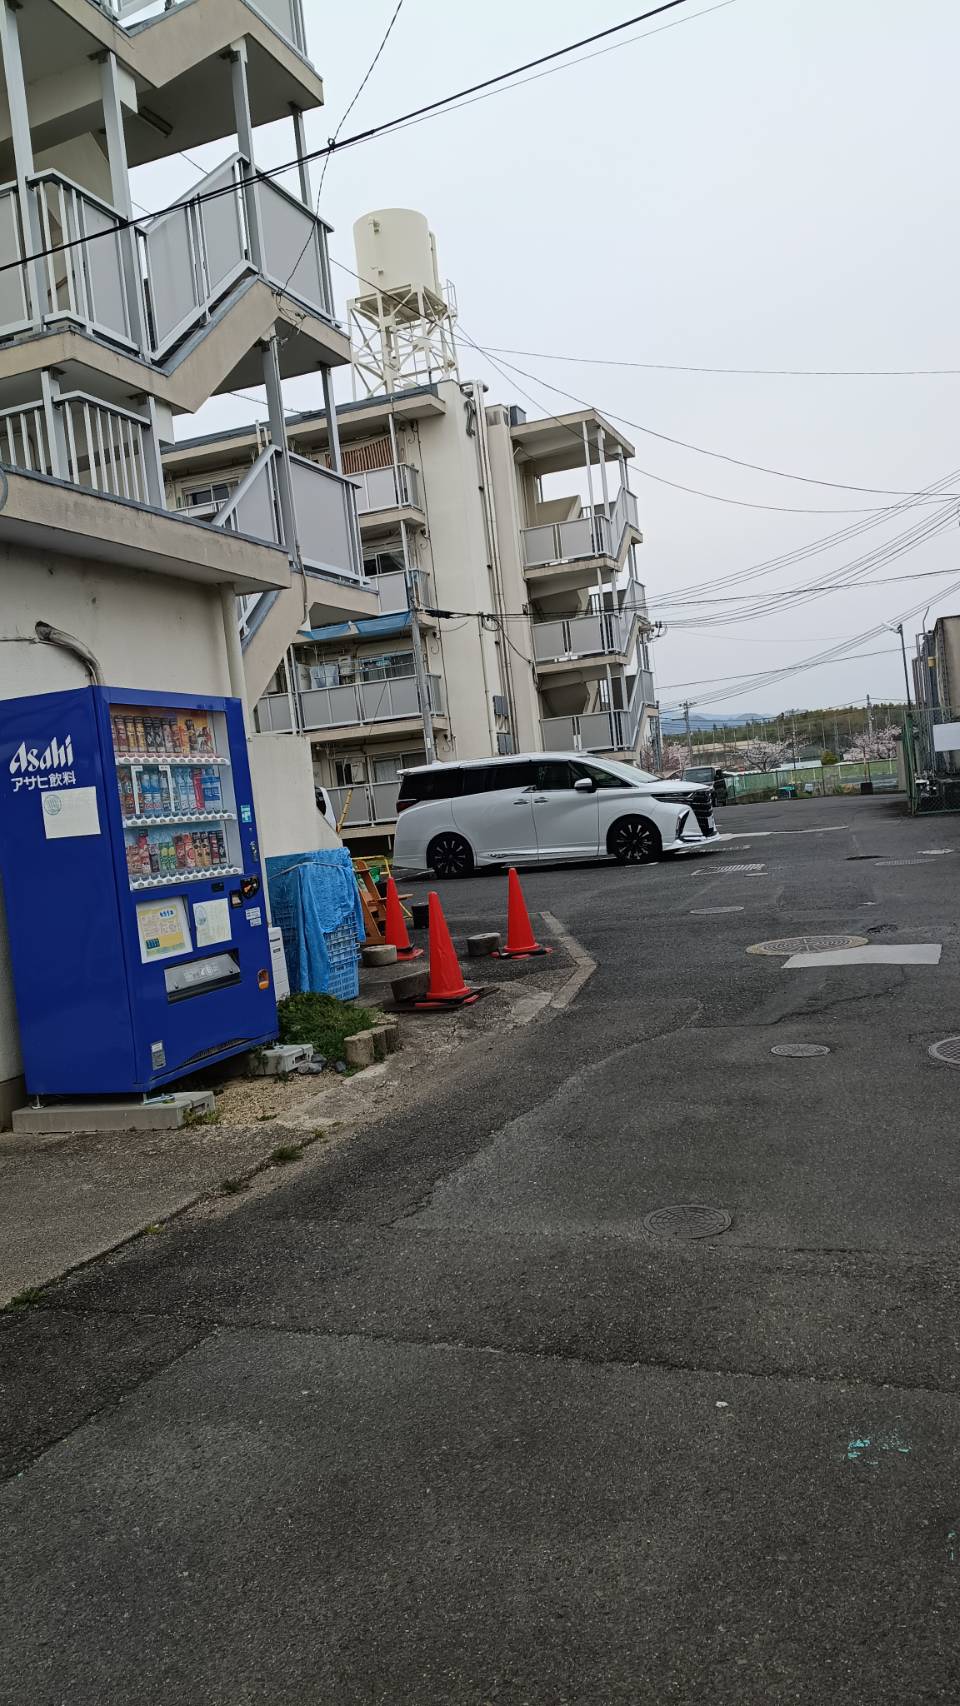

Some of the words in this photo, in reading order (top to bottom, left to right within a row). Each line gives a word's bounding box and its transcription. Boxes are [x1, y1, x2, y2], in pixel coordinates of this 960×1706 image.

[9, 734, 74, 774] Asahi
[10, 770, 77, 792] アサヒ飲料
